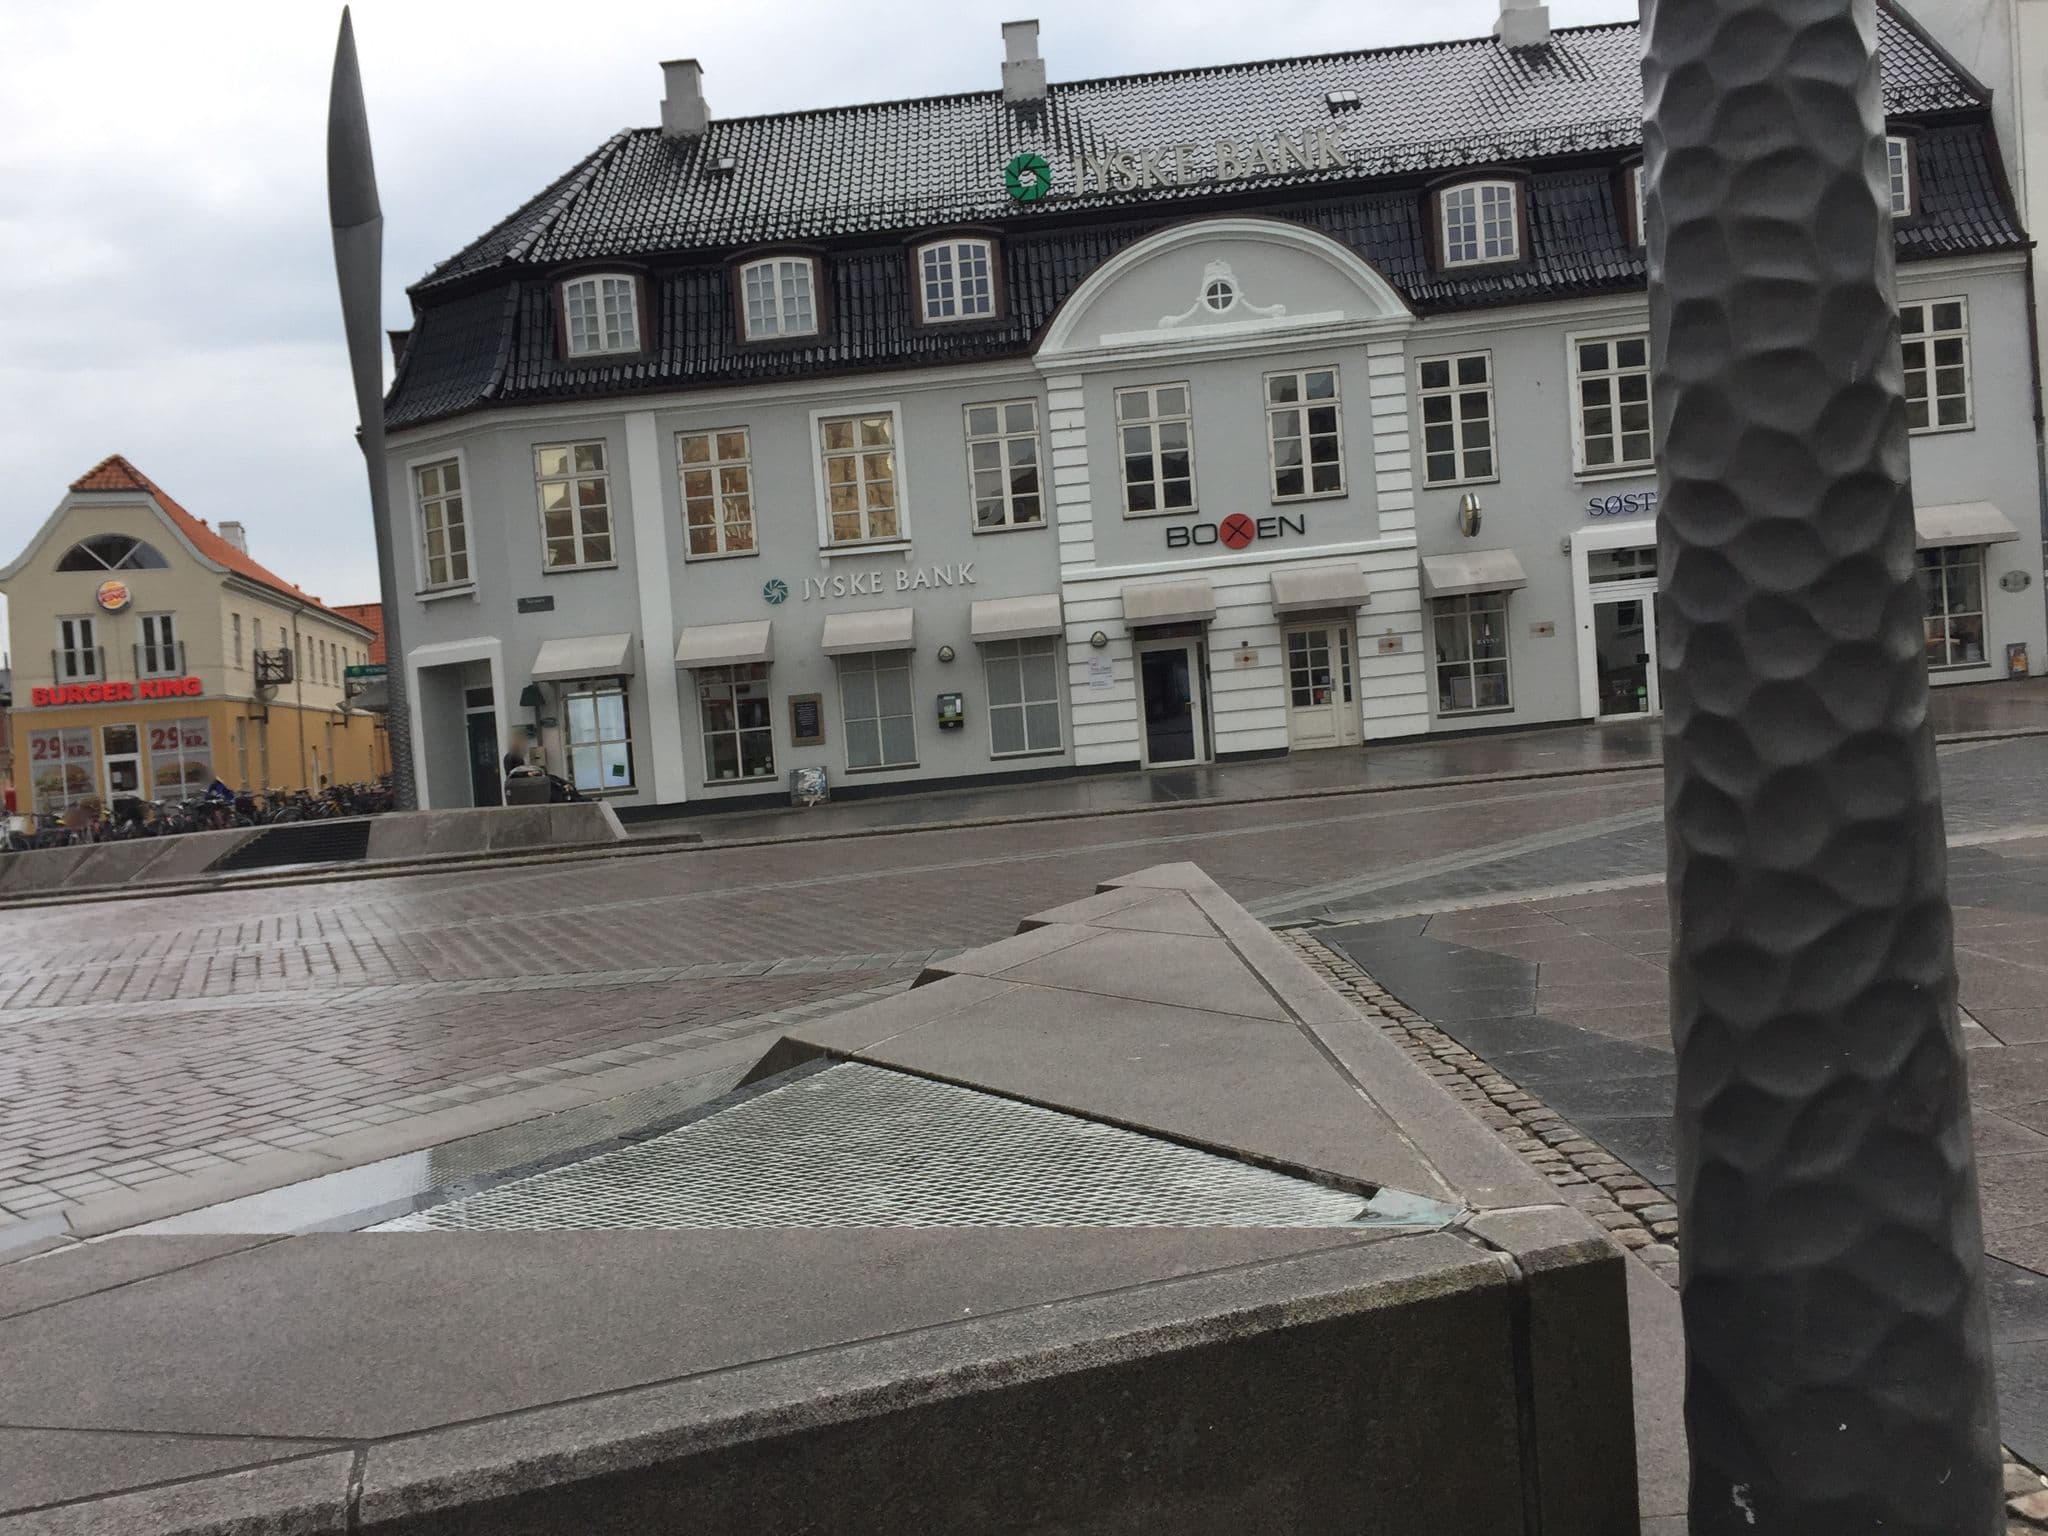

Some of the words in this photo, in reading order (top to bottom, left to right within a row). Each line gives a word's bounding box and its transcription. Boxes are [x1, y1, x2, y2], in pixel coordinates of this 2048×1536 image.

[1072, 142, 1199, 199] JYSKE
[1213, 125, 1352, 183] BANK
[1588, 491, 1658, 517] SØST
[1166, 513, 1305, 550] BOXEN
[802, 571, 884, 602] JYSKE
[895, 562, 976, 592] BANK
[31, 683, 133, 706] BURGER
[139, 677, 202, 699] KING
[32, 735, 64, 761] 29
[151, 726, 182, 751] 29
